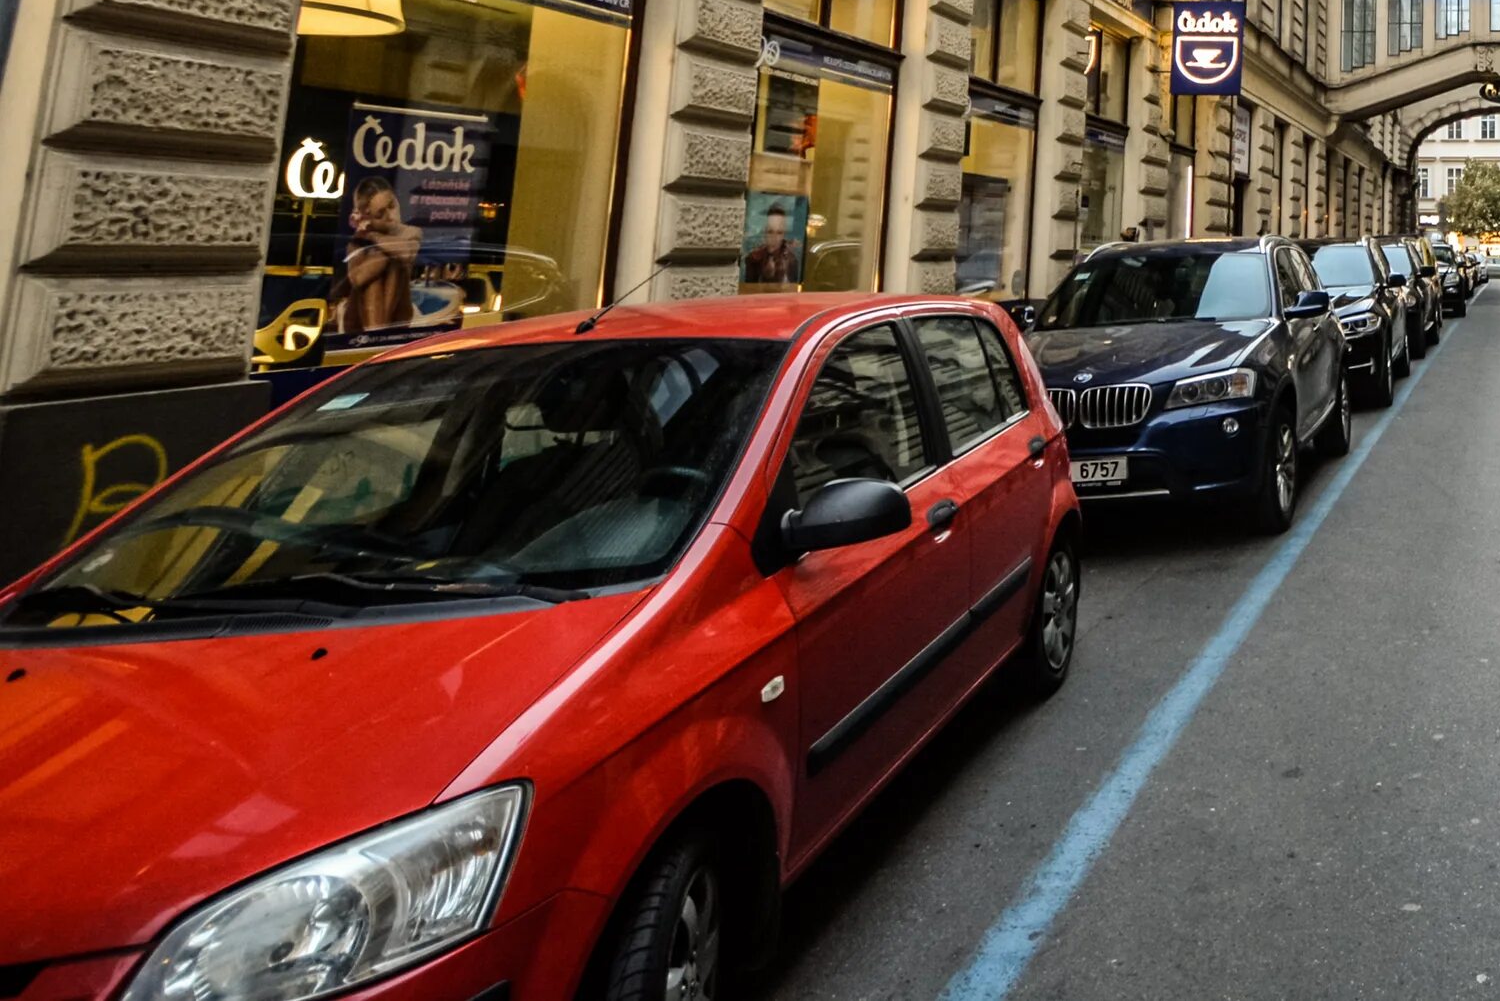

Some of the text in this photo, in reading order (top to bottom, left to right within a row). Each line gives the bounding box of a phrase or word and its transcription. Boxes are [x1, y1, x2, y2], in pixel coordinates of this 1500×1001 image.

[1177, 10, 1238, 33] Čedok
[353, 115, 476, 173] Čedok
[1080, 461, 1119, 479] 6757
